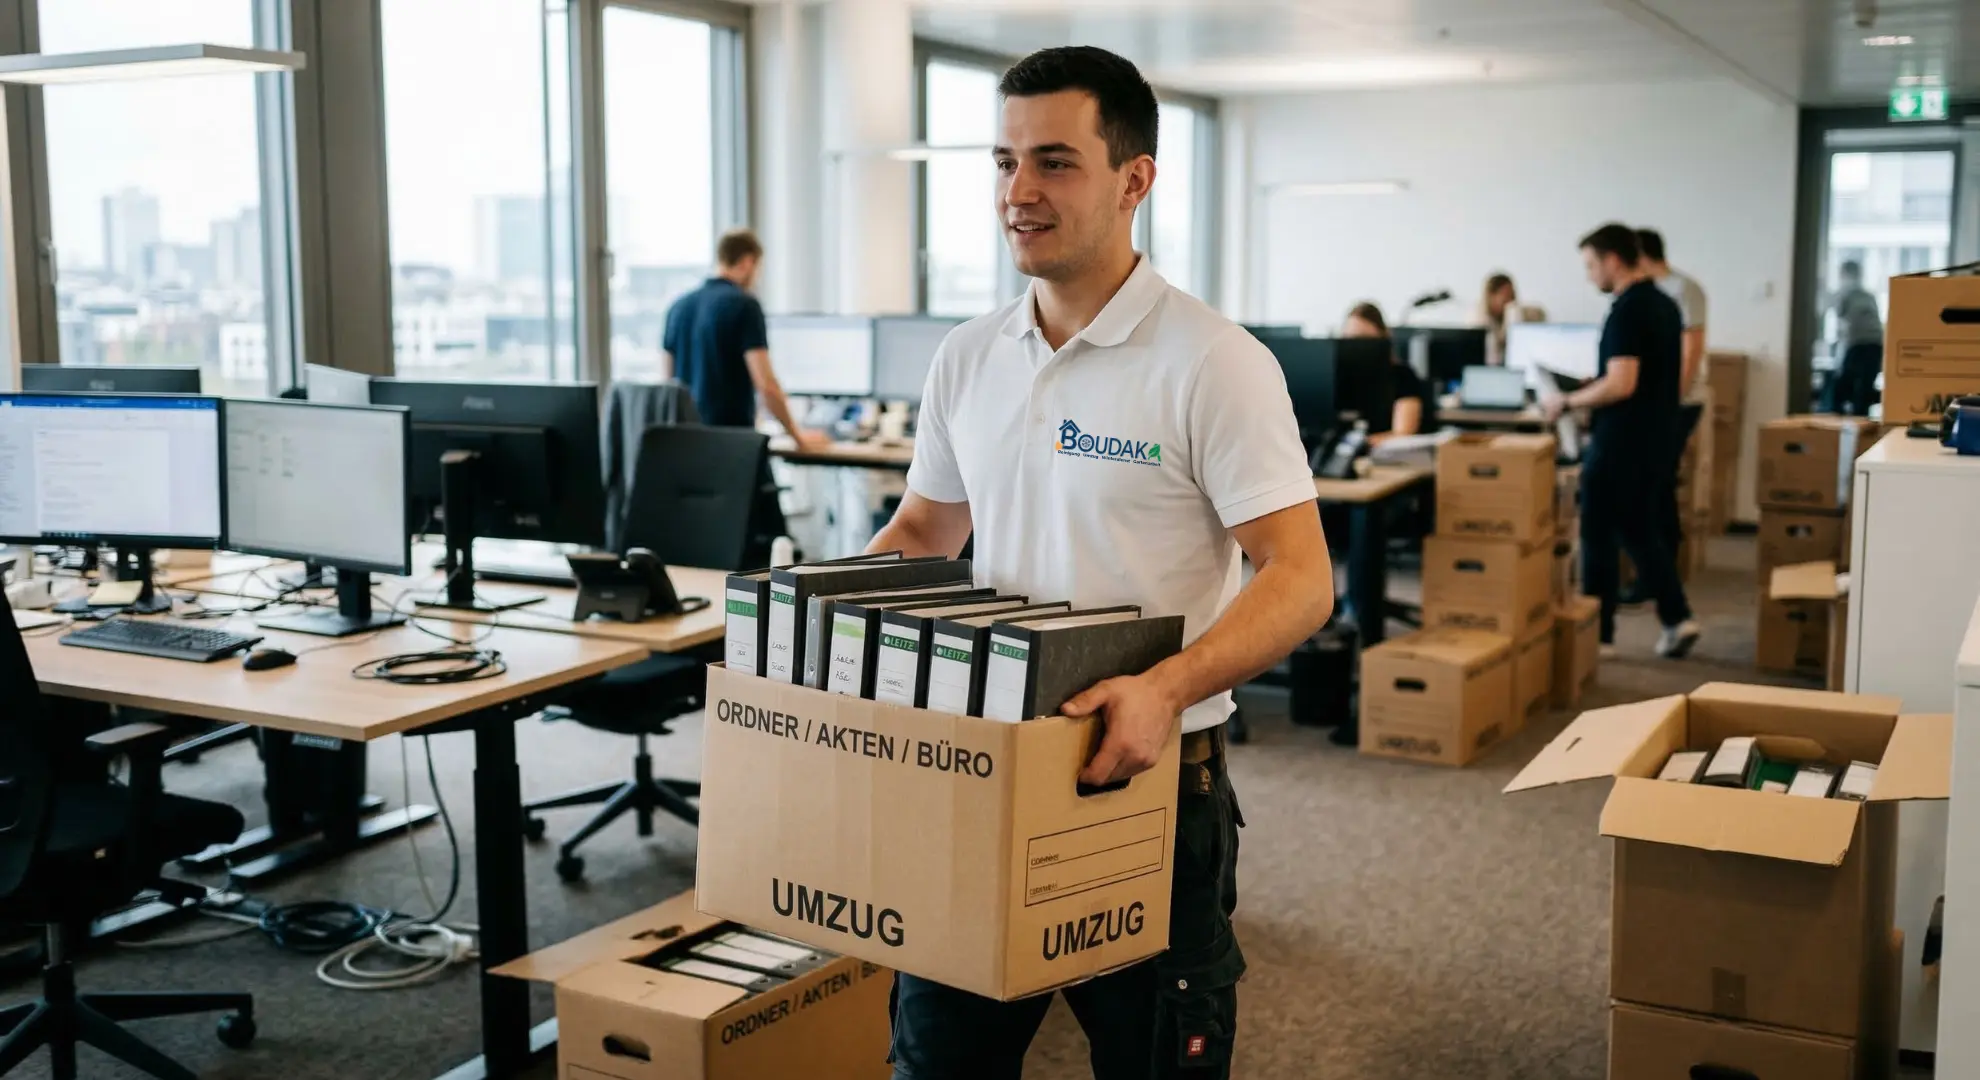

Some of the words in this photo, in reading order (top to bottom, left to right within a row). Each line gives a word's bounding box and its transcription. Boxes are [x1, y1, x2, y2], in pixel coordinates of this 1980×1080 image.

[1060, 427, 1148, 460] BOUDAK
[890, 636, 915, 651] LEITZ
[943, 647, 969, 662] LEITZ
[717, 698, 799, 741] ORDNER
[804, 719, 812, 743] /
[815, 722, 895, 761] AKTEN
[901, 738, 910, 764] /
[916, 738, 994, 779] BÜRO
[772, 877, 905, 948] UMZUG
[1042, 900, 1145, 961] UMZUG
[721, 999, 790, 1045] ORDNER
[800, 970, 851, 1010] AKTEN
